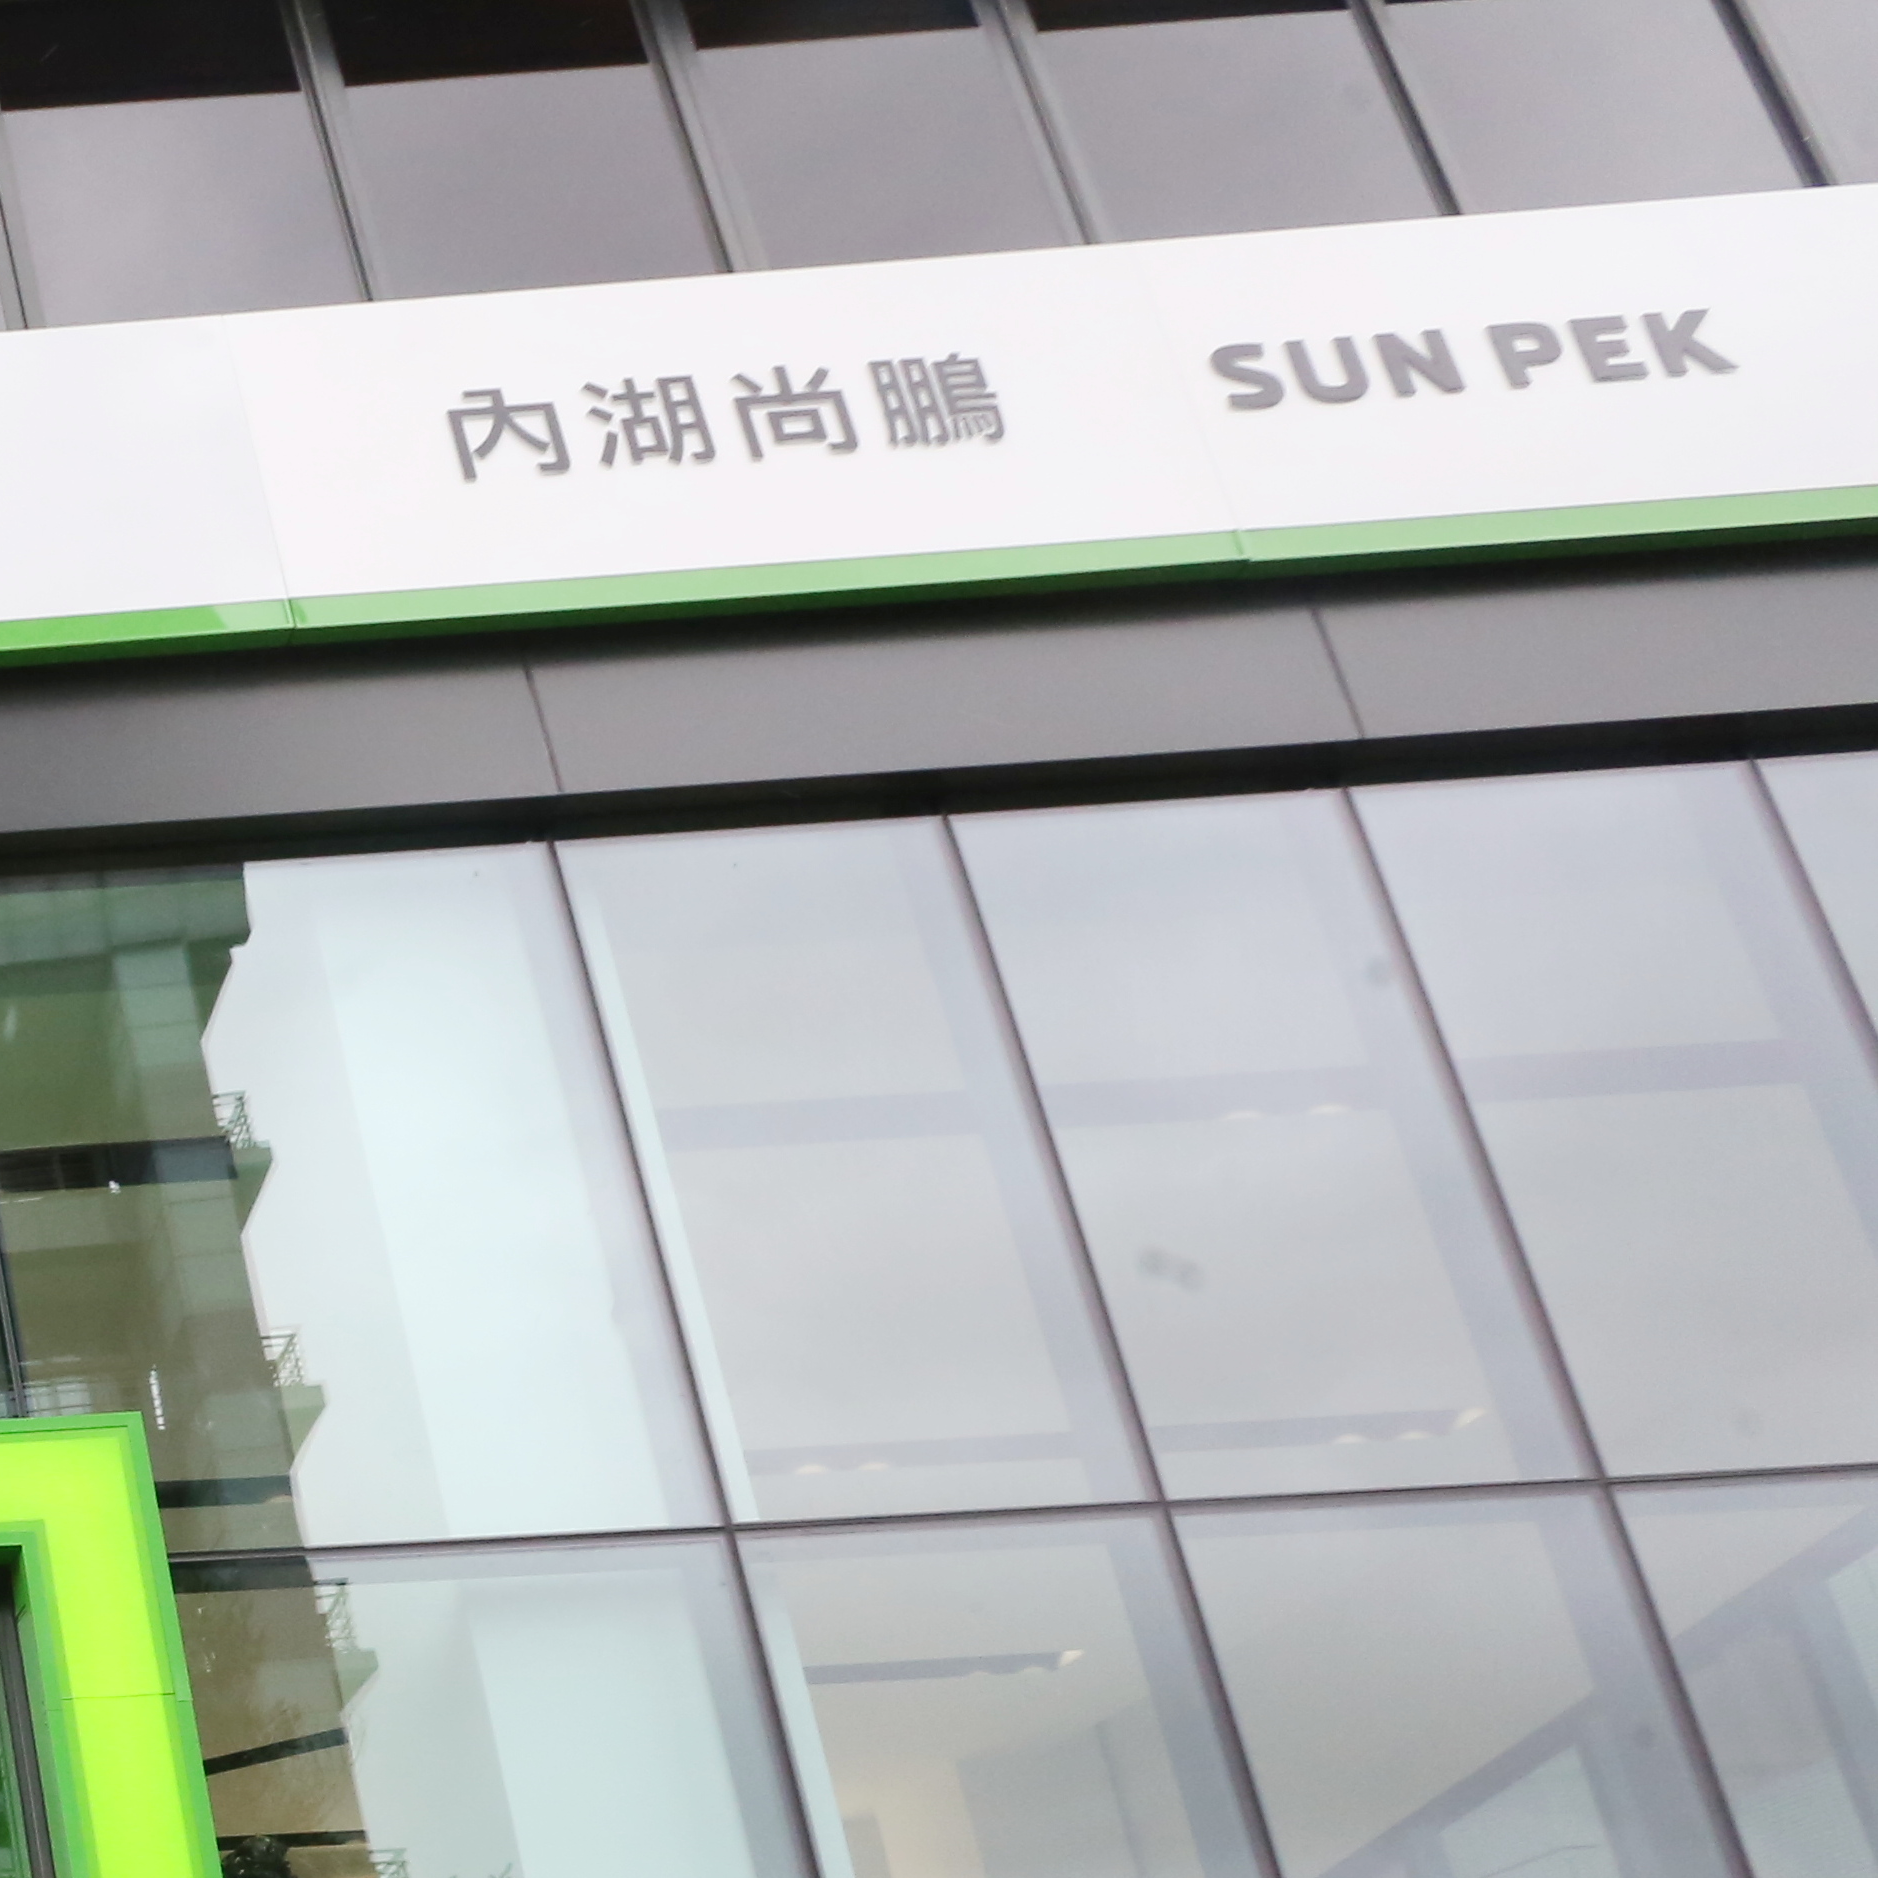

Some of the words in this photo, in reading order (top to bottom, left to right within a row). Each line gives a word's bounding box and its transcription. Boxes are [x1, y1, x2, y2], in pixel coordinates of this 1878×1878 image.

[447, 353, 1004, 482] 內湖尚鵬
[1210, 330, 1465, 411] SUN
[1486, 310, 1737, 389] PEK
